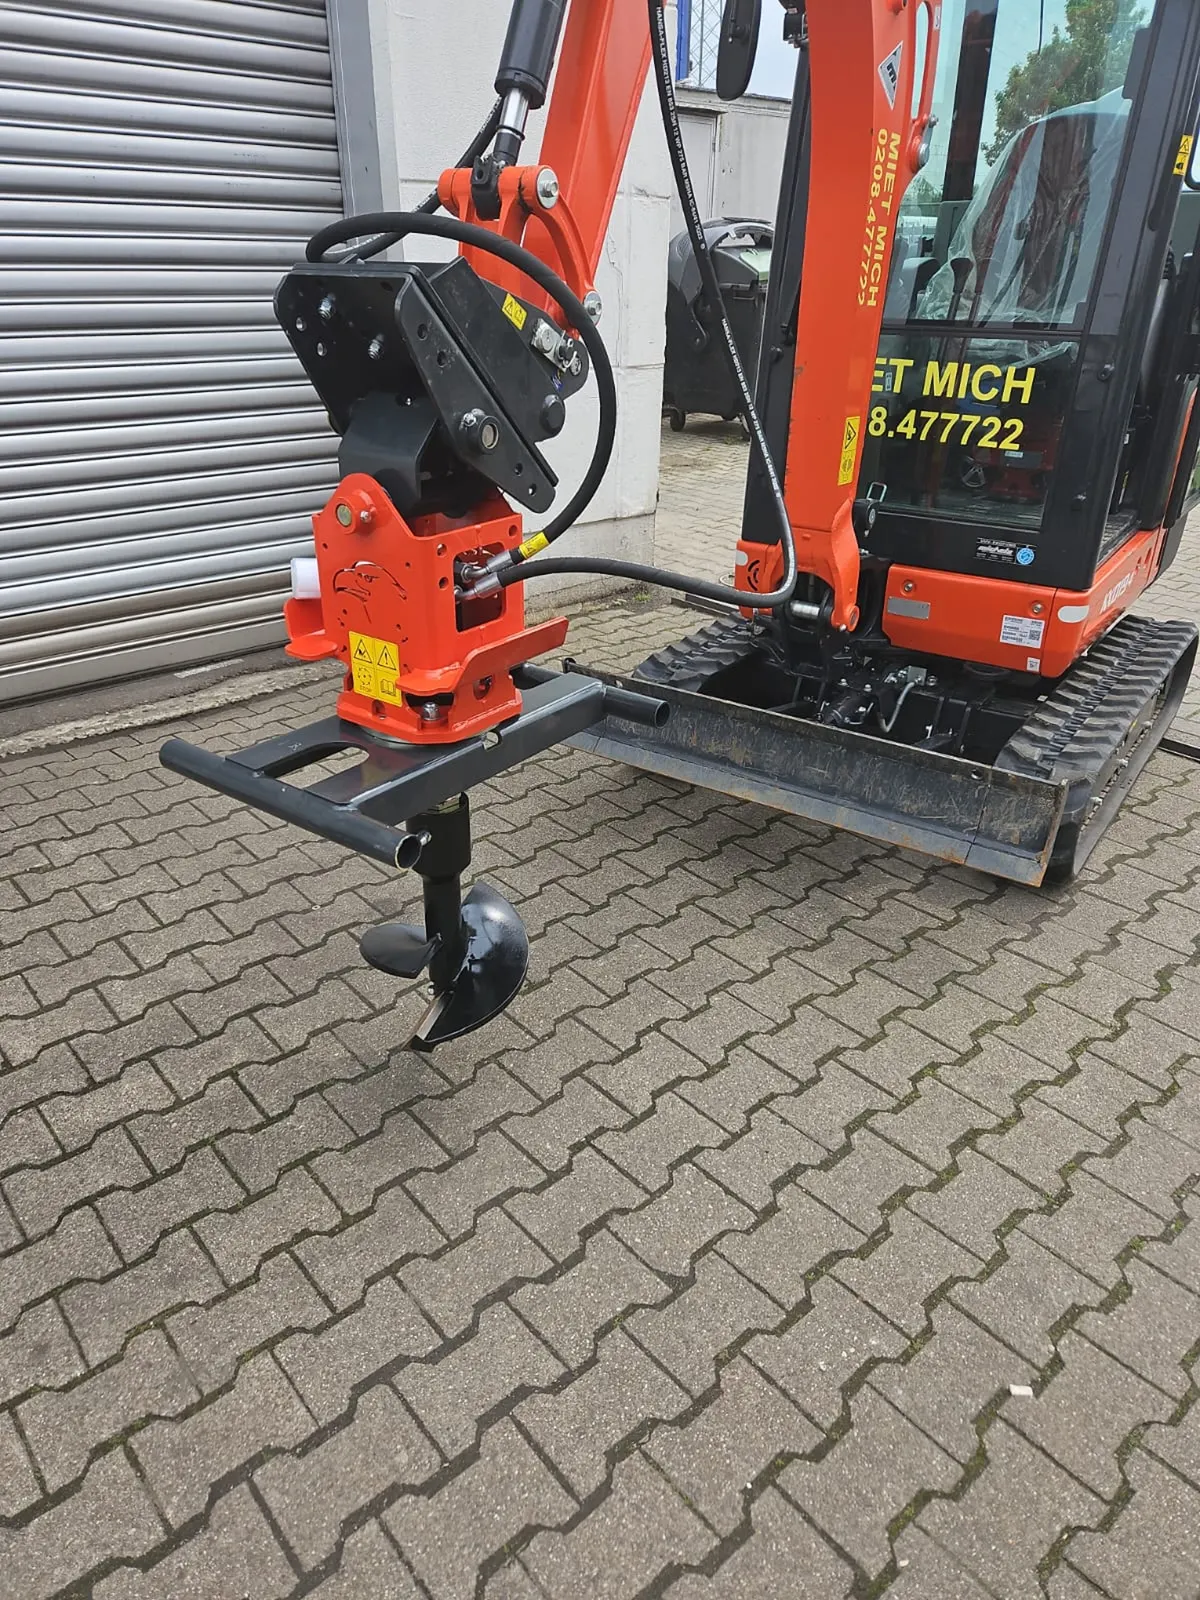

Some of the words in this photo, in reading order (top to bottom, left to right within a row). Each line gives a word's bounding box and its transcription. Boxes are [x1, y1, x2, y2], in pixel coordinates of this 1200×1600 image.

[879, 132, 902, 216] MIET
[857, 128, 888, 306] 0208.477722
[866, 225, 889, 307] MICH
[922, 360, 1036, 404] MICH
[868, 405, 1025, 451] 8.477722
